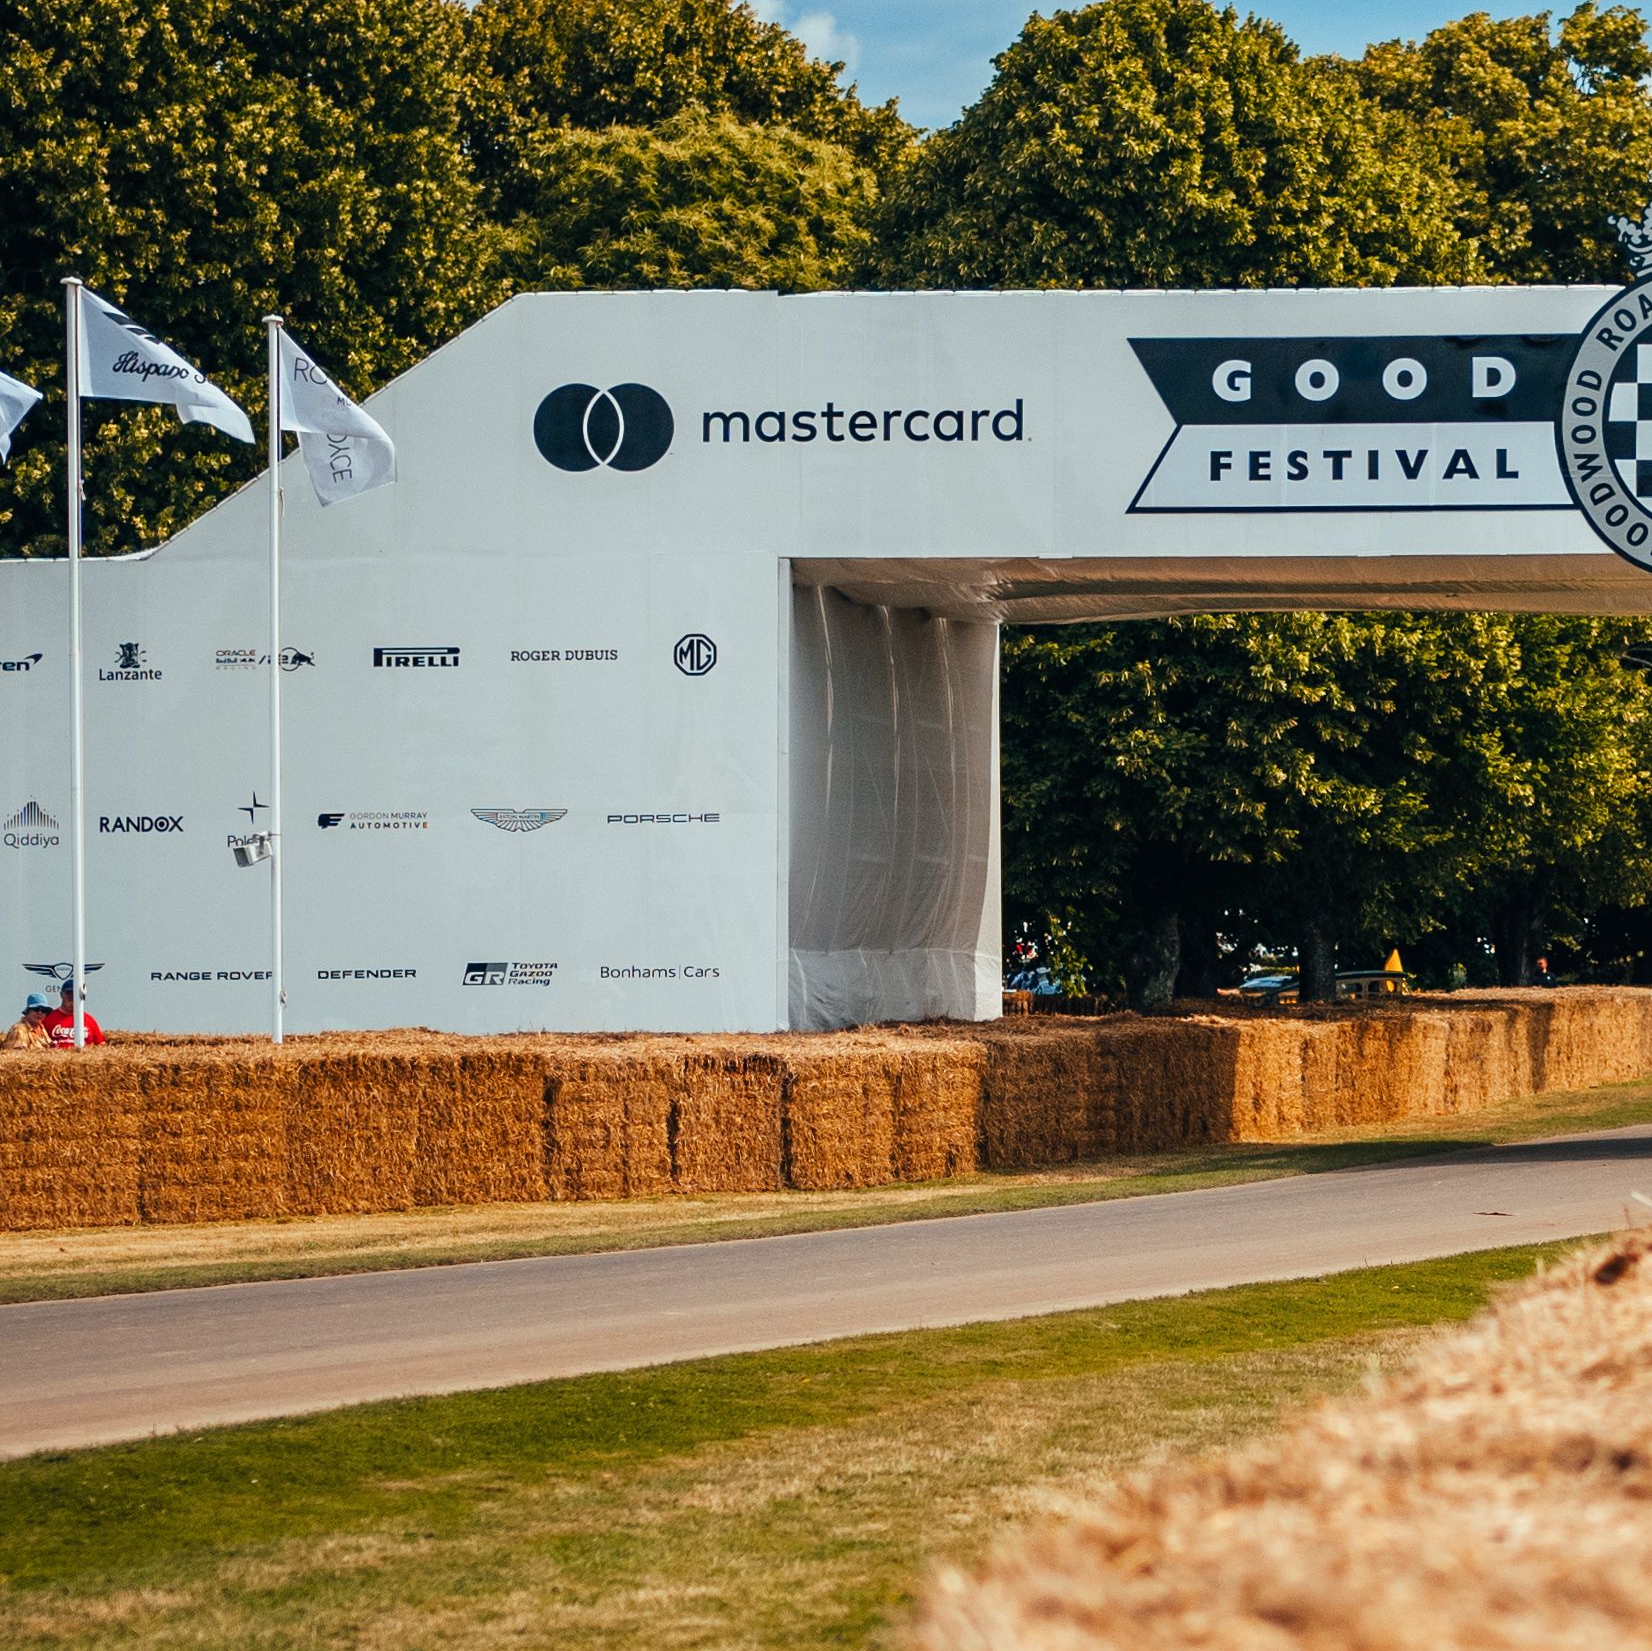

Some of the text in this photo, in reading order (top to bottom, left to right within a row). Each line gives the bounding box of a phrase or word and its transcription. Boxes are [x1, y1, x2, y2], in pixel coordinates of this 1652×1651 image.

[112, 351, 189, 382] Hispano
[1212, 356, 1516, 402] GOOD
[703, 398, 1024, 442] mastercard
[1210, 449, 1519, 481] FESTIVAL
[373, 647, 460, 667] PIRELLI
[510, 649, 618, 662] ROGER DUBUIS
[679, 638, 713, 671] MG
[99, 668, 163, 681] Lanzante
[100, 816, 183, 832] RANDOX
[607, 813, 720, 824] PORSCHE
[350, 822, 428, 830] AUTOMOTIVE
[4, 833, 59, 849] Qiddiya
[511, 962, 558, 970] TOYOTA
[600, 965, 720, 979] Bonhams Cars
[150, 971, 212, 981] RANGE
[318, 969, 417, 979] DEFENDER
[464, 971, 505, 985] GR
[509, 970, 553, 978] GAZOO
[508, 978, 551, 987] Racing
